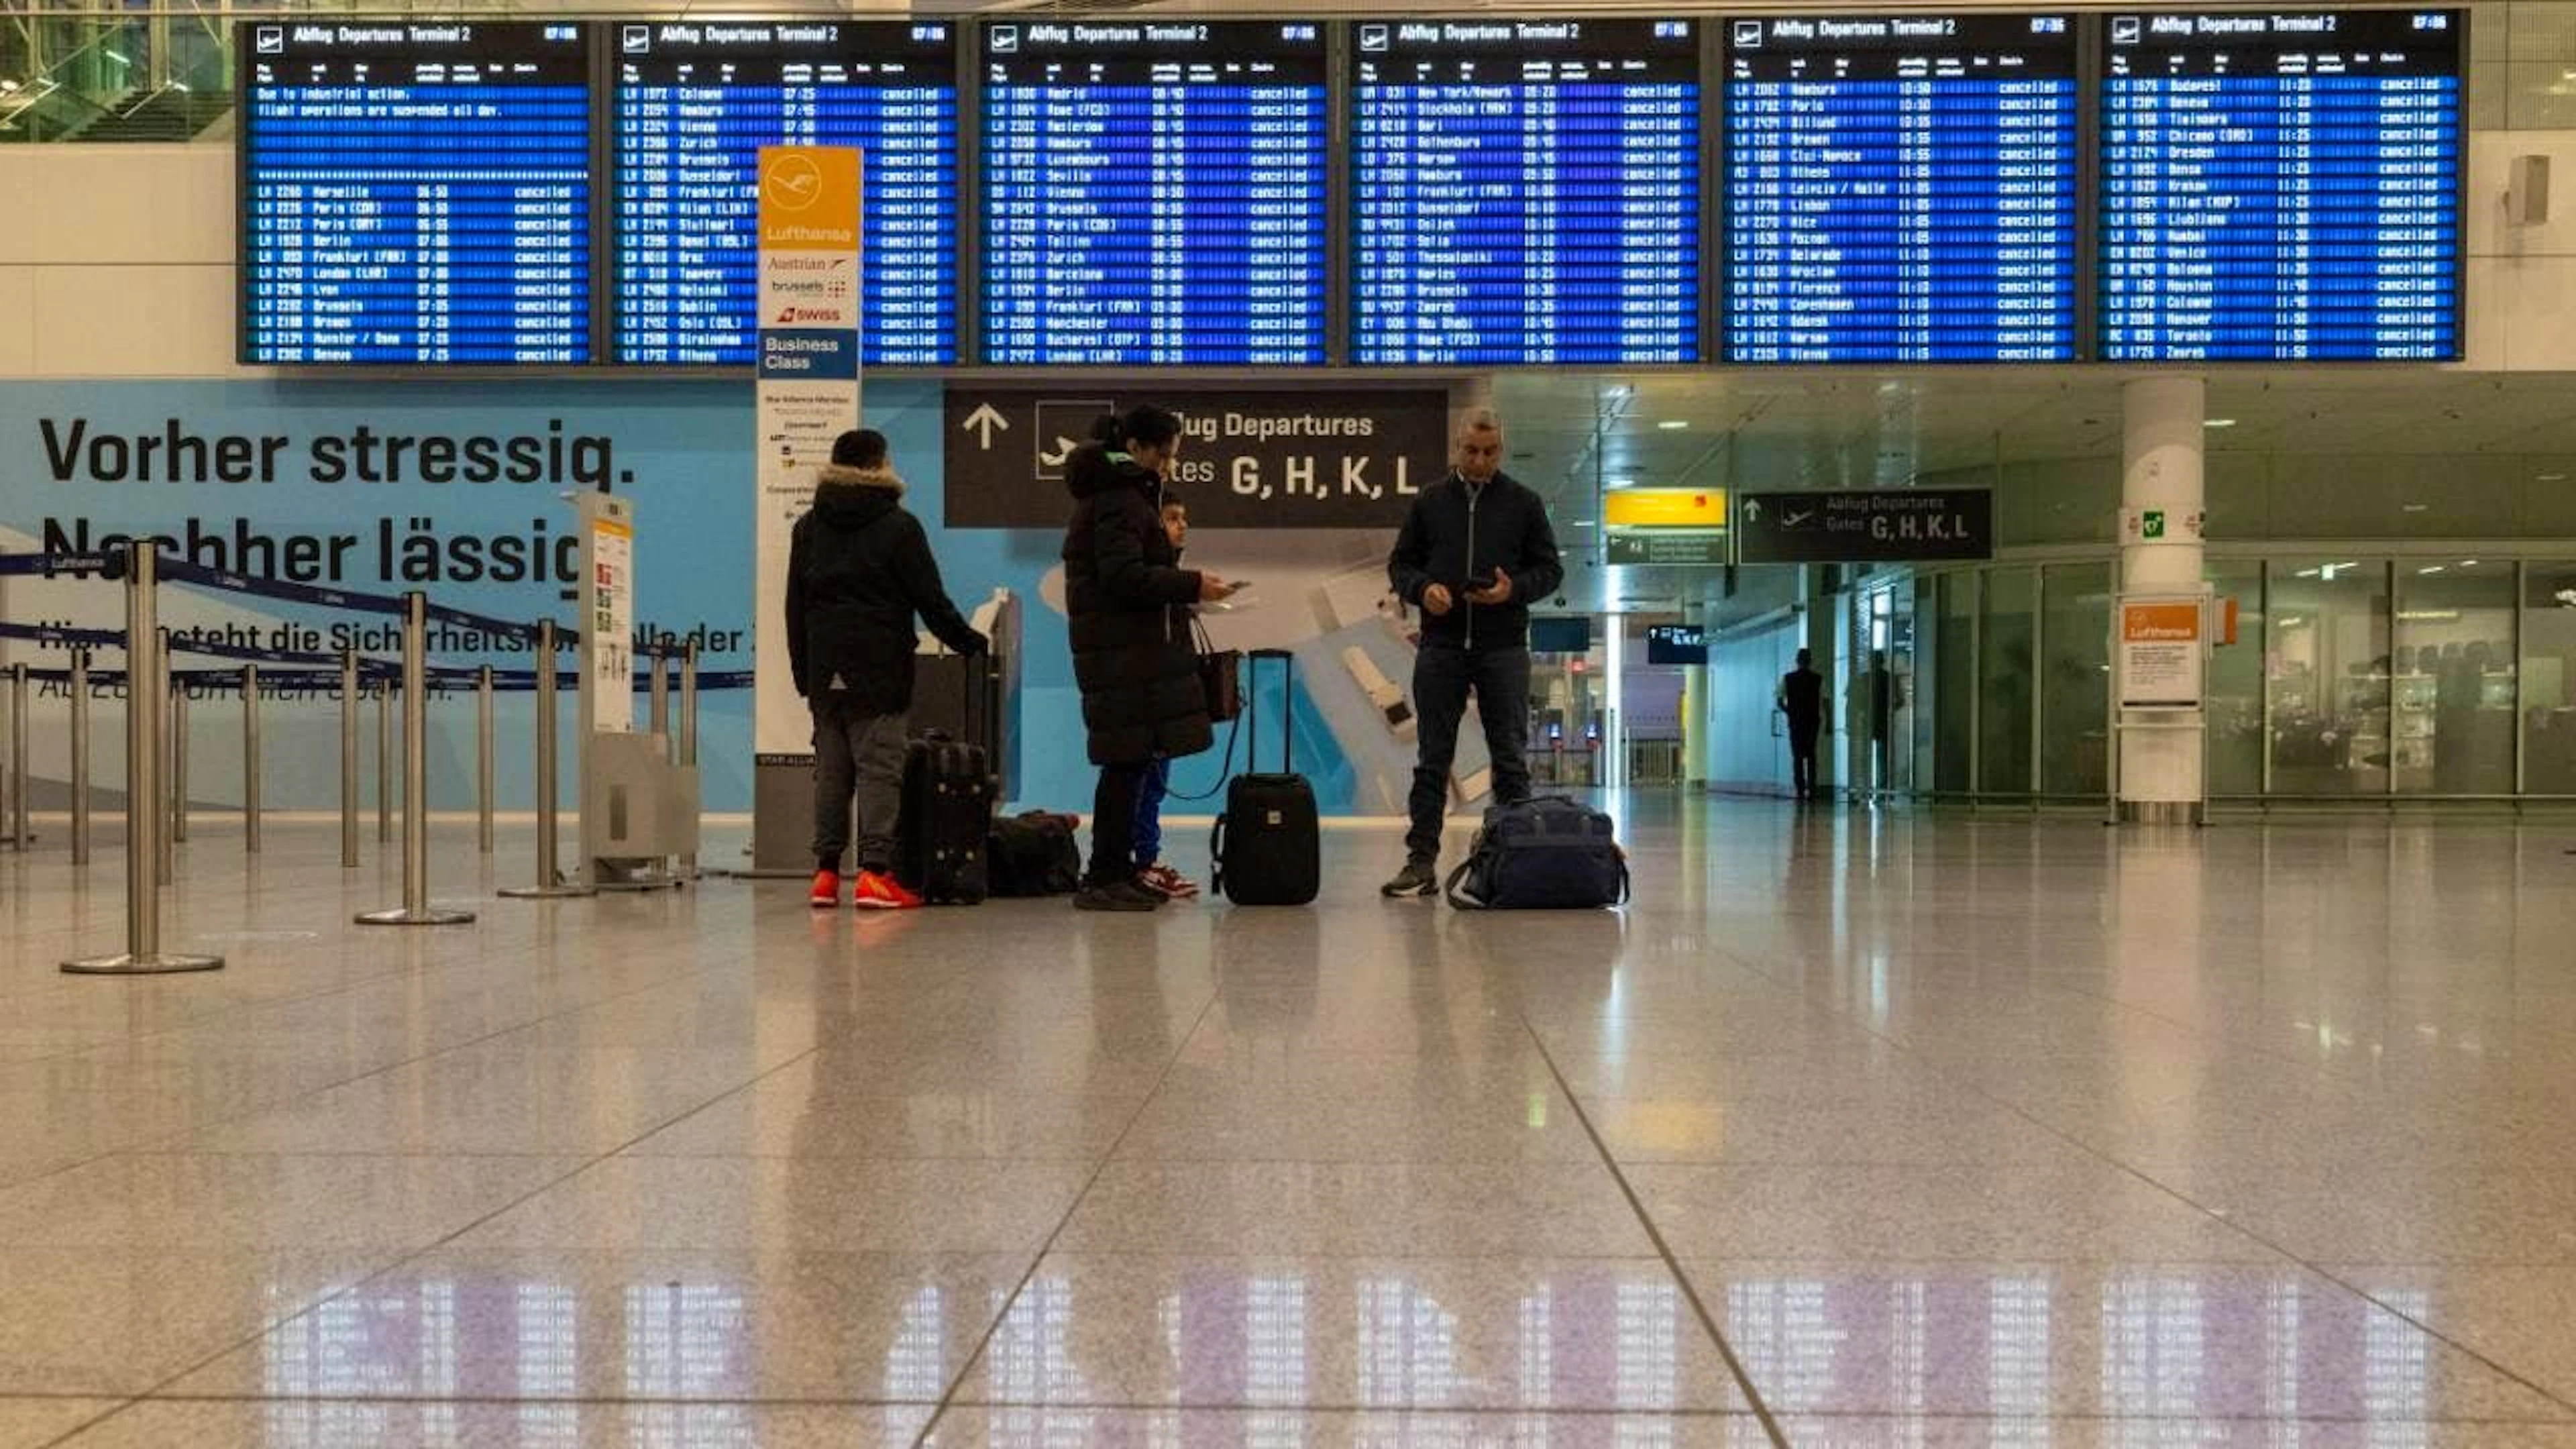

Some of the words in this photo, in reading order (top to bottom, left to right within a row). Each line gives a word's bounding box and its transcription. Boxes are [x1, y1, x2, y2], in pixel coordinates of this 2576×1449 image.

[1772, 20, 1814, 38] Abflug
[1819, 20, 1886, 38] Departures
[1891, 19, 1945, 35] Terminal
[1946, 19, 1955, 35] 2
[2151, 16, 2192, 35] Abflug
[2198, 16, 2265, 34] Departures
[2271, 15, 2324, 31] Terminal
[2325, 15, 2336, 31] 2
[293, 27, 333, 44] Abflug
[339, 26, 403, 44] Departures
[409, 26, 460, 41] Terminal
[462, 26, 471, 41] 2
[659, 25, 700, 44] Abflug
[706, 25, 770, 44] Departures
[776, 25, 828, 41] Terminal
[829, 25, 839, 41] 2
[1028, 25, 1069, 43] Abflug
[1074, 25, 1140, 43] Departures
[1145, 25, 1197, 40] Terminal
[1198, 25, 1208, 40] 2
[1399, 24, 1440, 42] Abflug
[1444, 24, 1511, 42] Departures
[1516, 23, 1567, 39] Terminal
[1569, 23, 1579, 39] 2
[1999, 82, 2057, 94] cancelled
[2380, 78, 2439, 90] cancelled
[258, 88, 276, 101] Due
[283, 88, 295, 101] to
[301, 88, 361, 101] industrial
[882, 88, 938, 100] cancelled
[1250, 88, 1308, 100] cancelled
[1623, 85, 1681, 98] cancelled
[301, 105, 363, 117] operations
[367, 105, 387, 117] are
[392, 105, 448, 117] suspended
[453, 104, 472, 117] all
[882, 121, 938, 133] cancelled
[1623, 119, 1681, 130] cancelled
[1999, 115, 2057, 127] cancelled
[2379, 146, 2438, 158] cancelled
[881, 171, 938, 182] cancelled
[514, 203, 571, 215] cancelled
[1622, 201, 1680, 213] cancelled
[1998, 215, 2056, 227] cancelled
[2378, 212, 2437, 224] cancelled
[767, 226, 851, 241] Lufthansa
[1997, 231, 2055, 243] cancelled
[515, 235, 571, 247] cancelled
[1250, 235, 1307, 248] cancelled
[1623, 234, 1680, 246] cancelled
[515, 252, 571, 263] cancelled
[1623, 251, 1680, 263] cancelled
[769, 257, 826, 270] Austrian
[1250, 268, 1307, 281] cancelled
[515, 284, 572, 296] cancelled
[772, 280, 824, 292] brussels
[881, 285, 937, 297] cancelled
[1250, 285, 1307, 297] cancelled
[2377, 280, 2436, 291] cancelled
[515, 301, 571, 313] cancelled
[1997, 298, 2055, 309] cancelled
[881, 318, 937, 329] cancelled
[1250, 318, 1307, 329] cancelled
[765, 337, 839, 352] Business
[2376, 346, 2435, 358] cancelled
[765, 355, 810, 370] Class
[1171, 411, 1218, 442] lug
[1225, 413, 1373, 442] Departures
[40, 419, 289, 484] Vorher
[310, 419, 634, 493] stressig.
[1170, 458, 1216, 482] tes
[1232, 455, 1273, 500] G,
[1285, 455, 1329, 500] H,
[1342, 455, 1383, 500] K,
[1397, 455, 1419, 495] L
[1872, 496, 1945, 511] Departures
[380, 518, 580, 600] lässig
[272, 622, 320, 651] die
[689, 622, 743, 652] der
